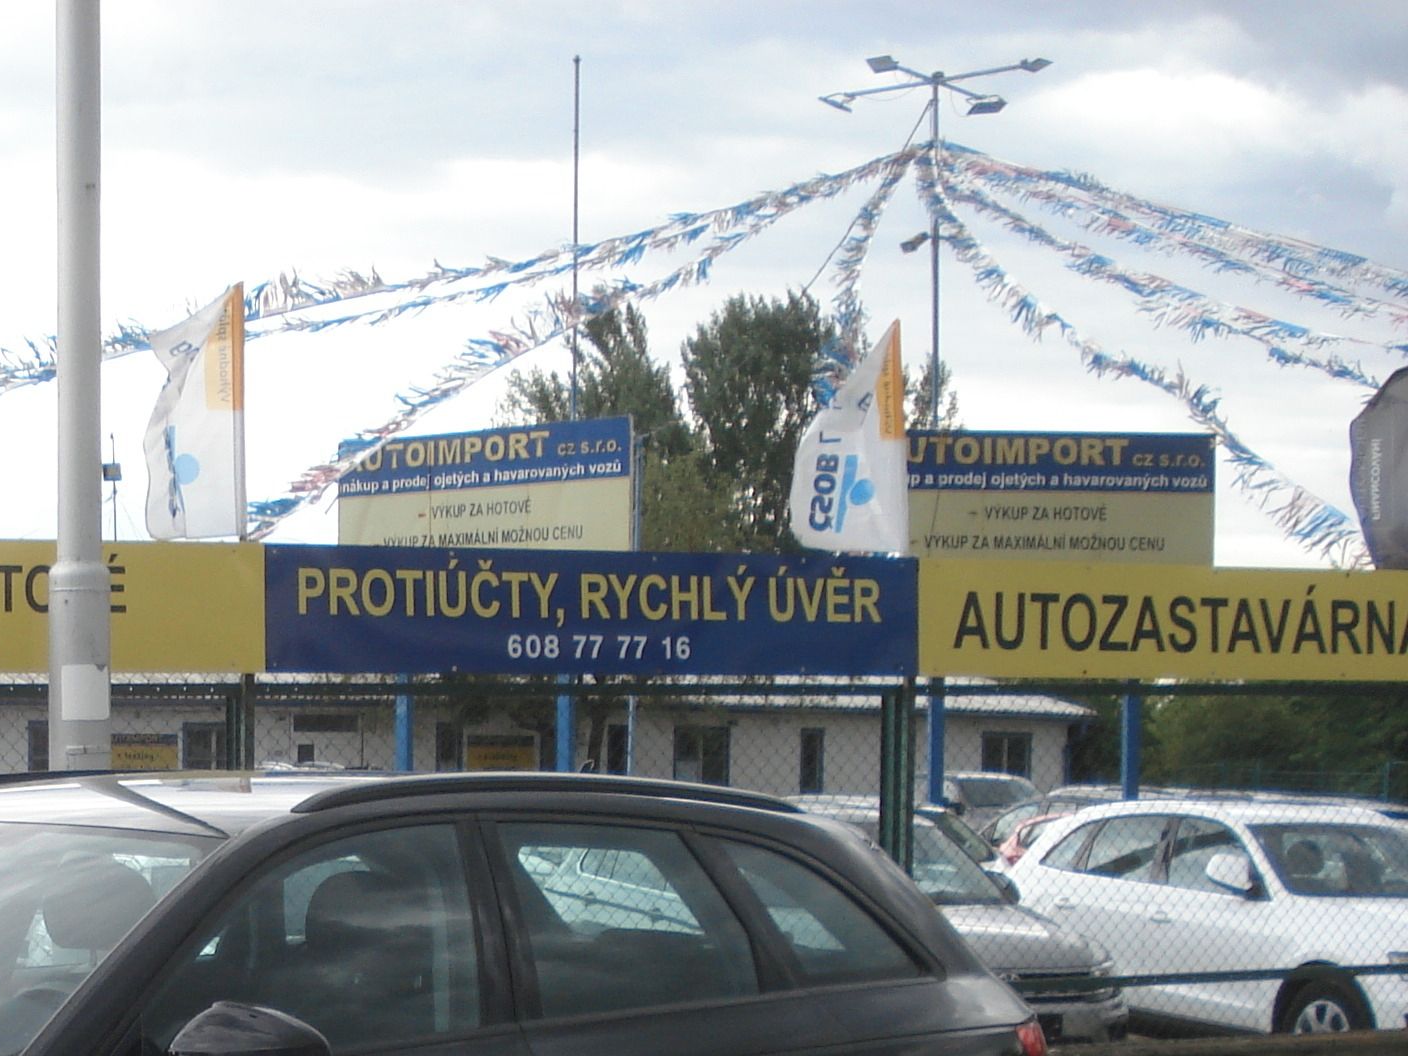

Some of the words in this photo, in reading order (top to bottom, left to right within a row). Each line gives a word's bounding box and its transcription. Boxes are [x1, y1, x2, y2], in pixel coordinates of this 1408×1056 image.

[355, 430, 550, 472] UTOIMPORT
[557, 443, 576, 456] cz
[580, 440, 622, 455] s.r.o.
[907, 436, 1130, 466] UTOIMPORT
[1132, 453, 1153, 467] cz
[1159, 453, 1206, 468] s.r.o.
[342, 479, 379, 493] nákup
[382, 480, 390, 490] a
[392, 474, 430, 492] prodej
[434, 471, 479, 489] ojetých
[482, 472, 490, 483] a
[494, 463, 585, 482] havarovaných
[589, 458, 622, 473] vozů
[924, 473, 934, 485] a
[938, 471, 986, 489] prodej
[991, 472, 1046, 489] ojetých
[1050, 474, 1059, 485] a
[1063, 473, 1169, 490] havarovaných
[469, 502, 483, 517] ZA
[486, 496, 532, 516] HOTOVÉ
[1032, 506, 1050, 520] ZA
[1053, 502, 1108, 521] HOTOVÉ
[421, 534, 436, 548] ZA
[438, 527, 499, 547] MAXIMÁLNÍ
[502, 525, 549, 543] MOŽNOU
[552, 525, 584, 540] CENU
[972, 536, 990, 550] ZA
[993, 533, 1066, 550] MAXIMÁLNÍ
[1069, 532, 1126, 551] MOŽNOU
[1129, 536, 1166, 551] CENU
[297, 559, 566, 627] PROTIÚČTY,
[580, 564, 755, 622] RYCHLÝ
[768, 566, 883, 624] ÚVĚR
[507, 635, 561, 660] 608
[573, 635, 603, 660] 77
[617, 636, 647, 661] 77
[662, 636, 691, 661] 16
